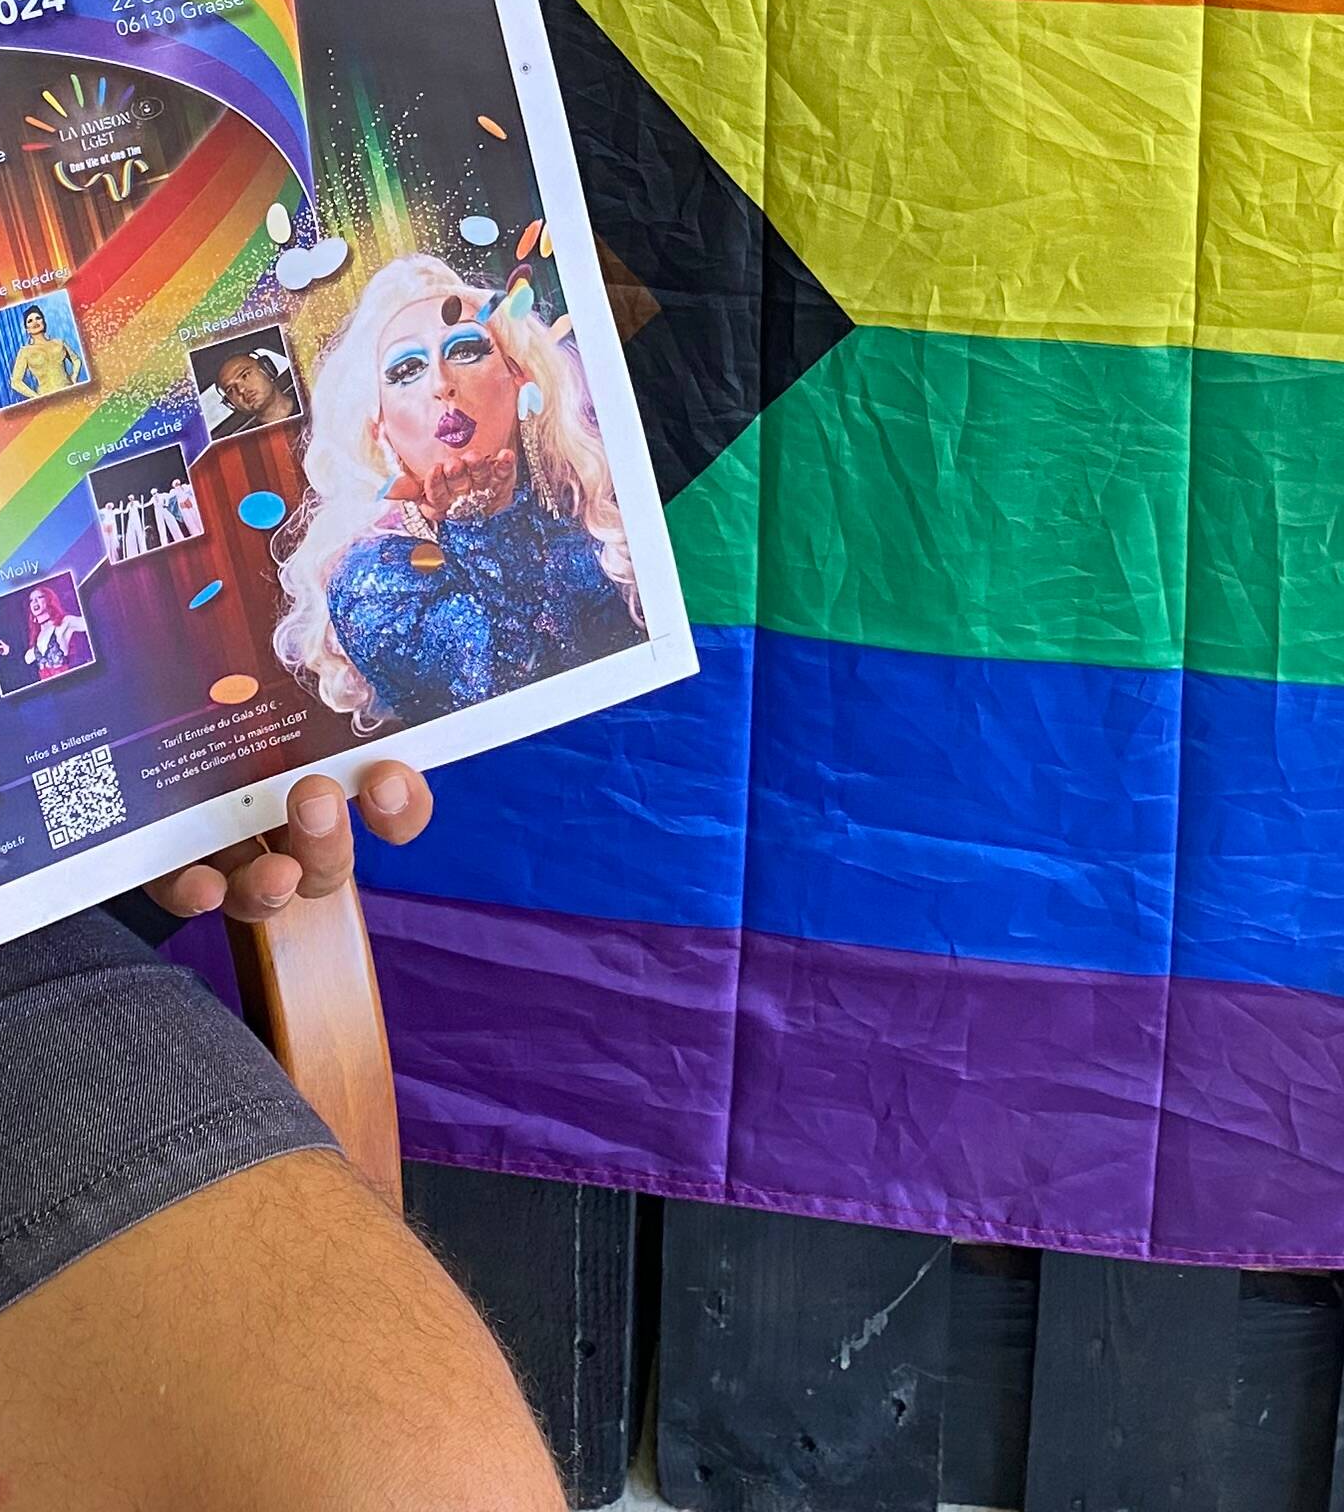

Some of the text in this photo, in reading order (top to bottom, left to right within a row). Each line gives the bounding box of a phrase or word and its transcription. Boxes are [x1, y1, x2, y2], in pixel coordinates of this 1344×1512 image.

[115, 6, 176, 36] 06130
[178, 325, 198, 342] DJ
[66, 418, 183, 466] Cie Haut-Perché
[0, 559, 40, 582] Molly
[162, 732, 183, 750] Tarif
[185, 723, 216, 742] Entrée
[217, 717, 231, 730] du
[232, 709, 255, 724] Gala
[255, 703, 268, 716] 50
[269, 699, 278, 711] €
[25, 748, 50, 765] Infos
[140, 766, 161, 780] Des
[160, 759, 177, 772] Vic
[177, 754, 189, 765] et
[189, 747, 207, 762] des
[207, 738, 227, 753] Tim
[233, 733, 246, 744] La
[247, 721, 281, 739] maison
[281, 709, 308, 727] LGBT
[156, 729, 302, 789] 6 rue des Grillons 06130 Grasse
